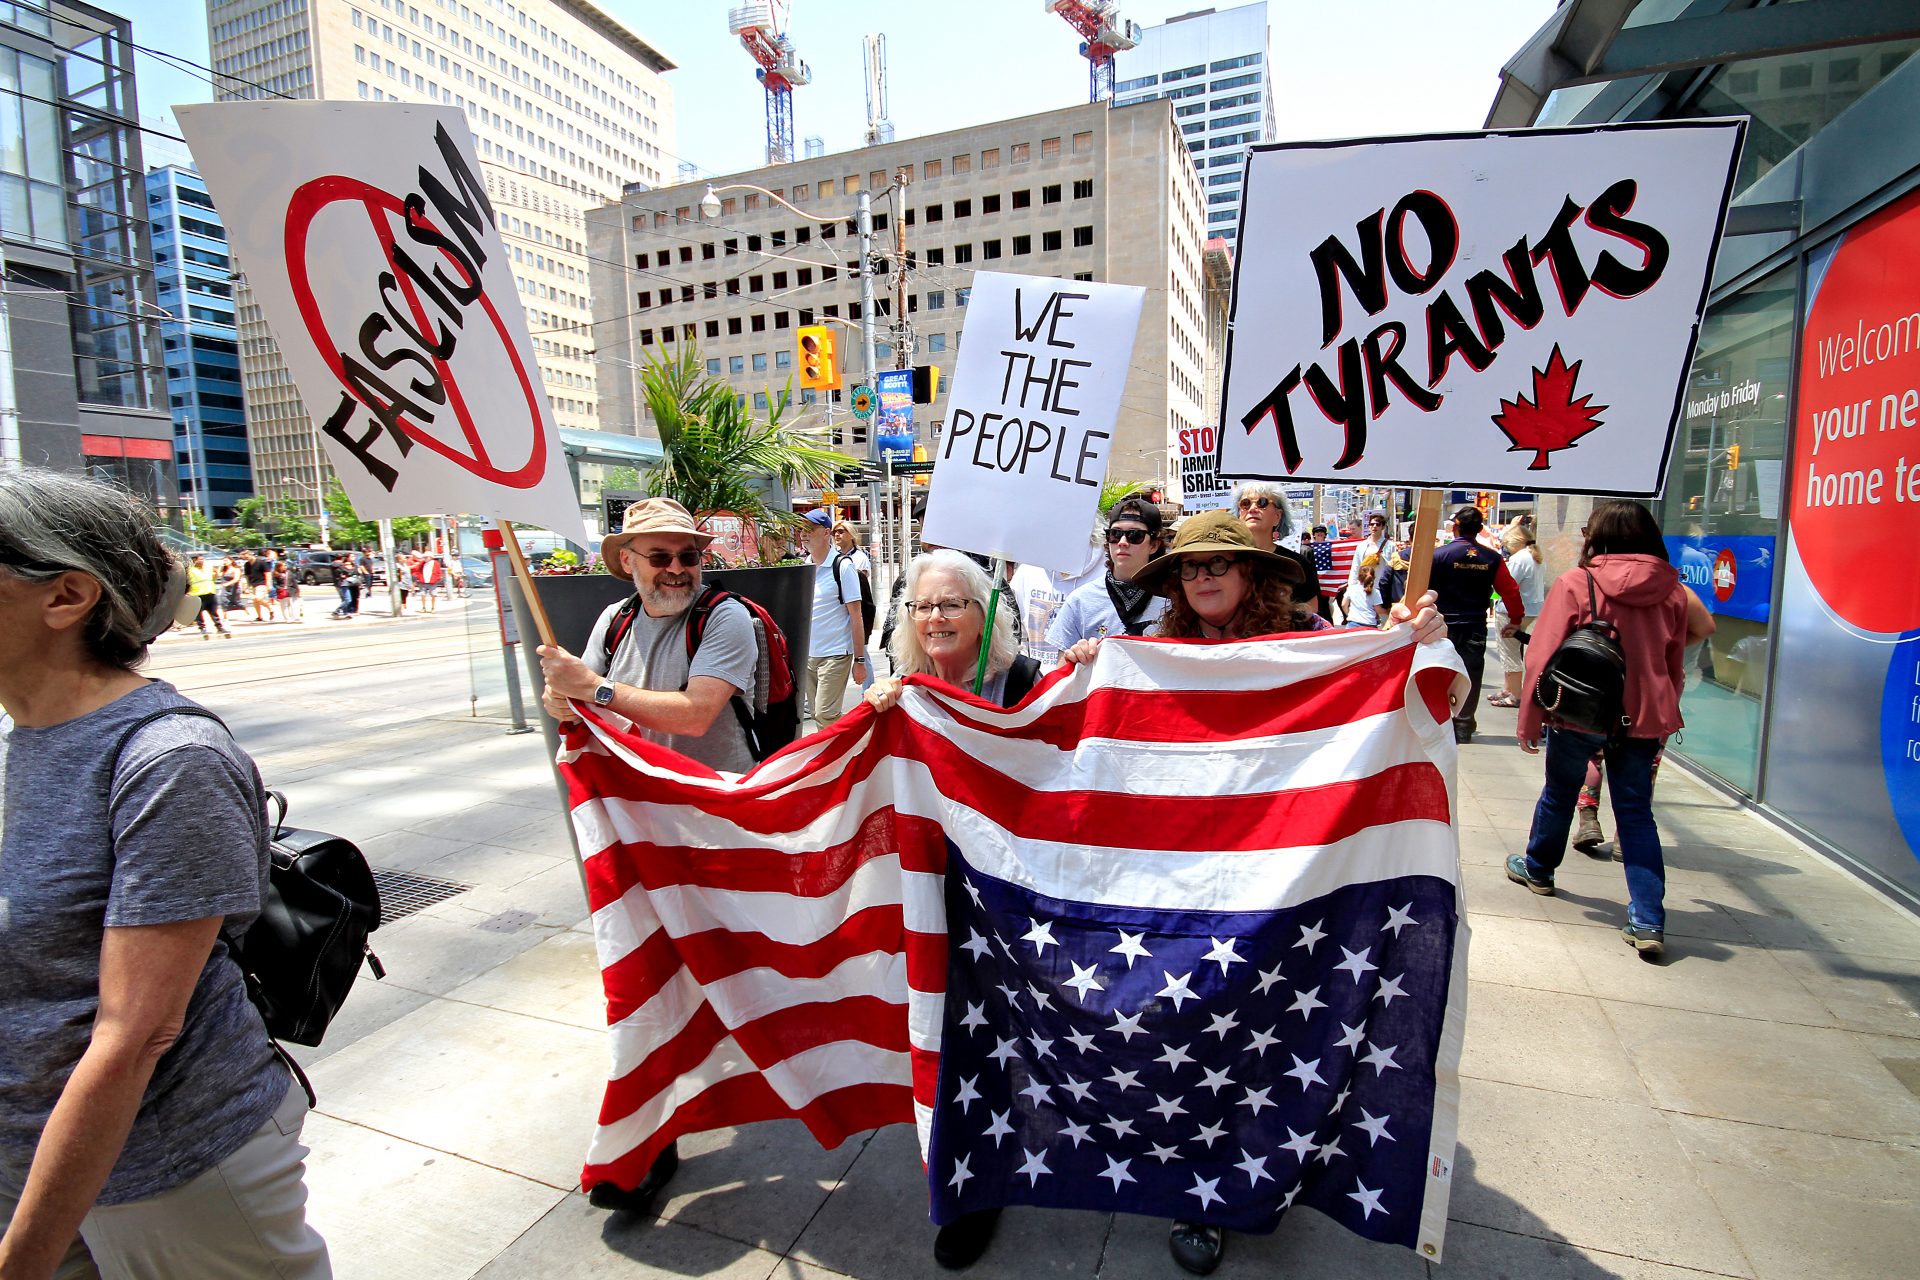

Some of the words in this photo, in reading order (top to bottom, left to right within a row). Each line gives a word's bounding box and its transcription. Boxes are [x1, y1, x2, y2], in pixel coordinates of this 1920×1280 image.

[1310, 189, 1460, 351] NO
[322, 120, 496, 493] FASCISM
[1015, 287, 1090, 349] WE
[1241, 178, 1670, 475] TYRANTS
[883, 374, 908, 383] GREAT
[1000, 350, 1092, 416] THE
[1686, 393, 1719, 419] Monday
[1721, 390, 1729, 409] to
[1731, 379, 1761, 405] Friday
[945, 408, 1110, 487] PEOPLE
[1179, 426, 1217, 455] STO
[1812, 399, 1872, 456] your
[1182, 472, 1231, 493] ISRAEL
[1806, 462, 1884, 508] home
[1030, 588, 1047, 600] GET
[1681, 564, 1709, 586] BMO
